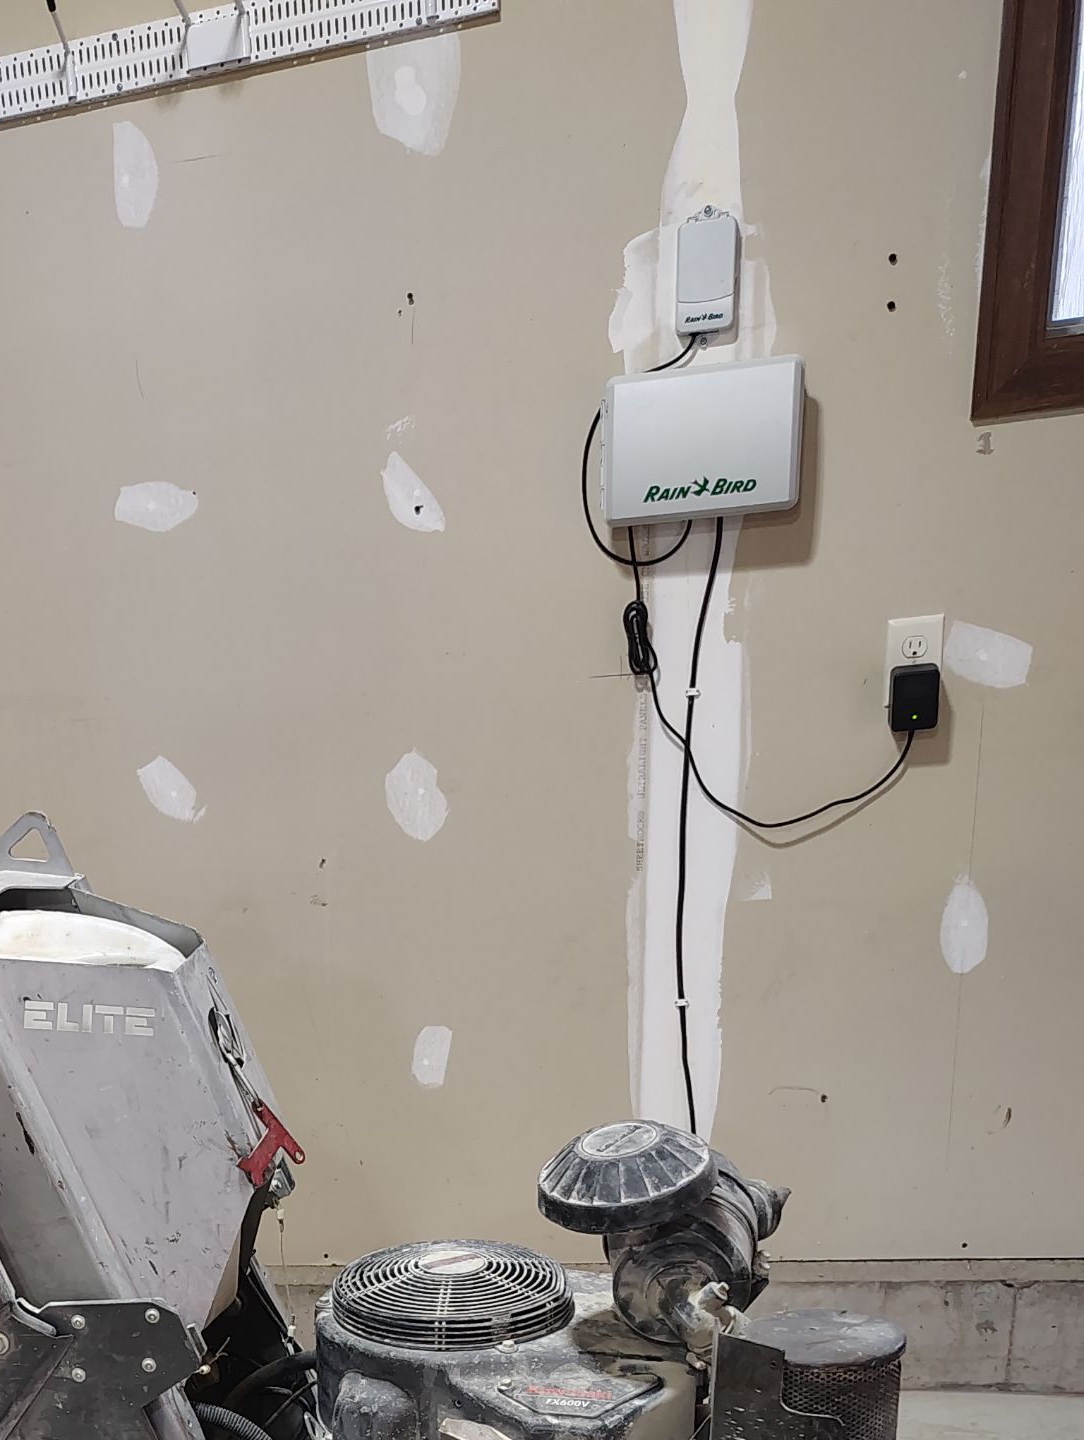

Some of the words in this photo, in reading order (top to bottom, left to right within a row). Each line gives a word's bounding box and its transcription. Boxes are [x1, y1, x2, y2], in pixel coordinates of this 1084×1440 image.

[684, 314, 702, 324] RAIN
[707, 312, 724, 321] BIRD
[643, 485, 693, 504] RAIN
[710, 477, 758, 497] BIRD
[23, 1000, 156, 1037] ELITE
[545, 1398, 591, 1408] FX600V
